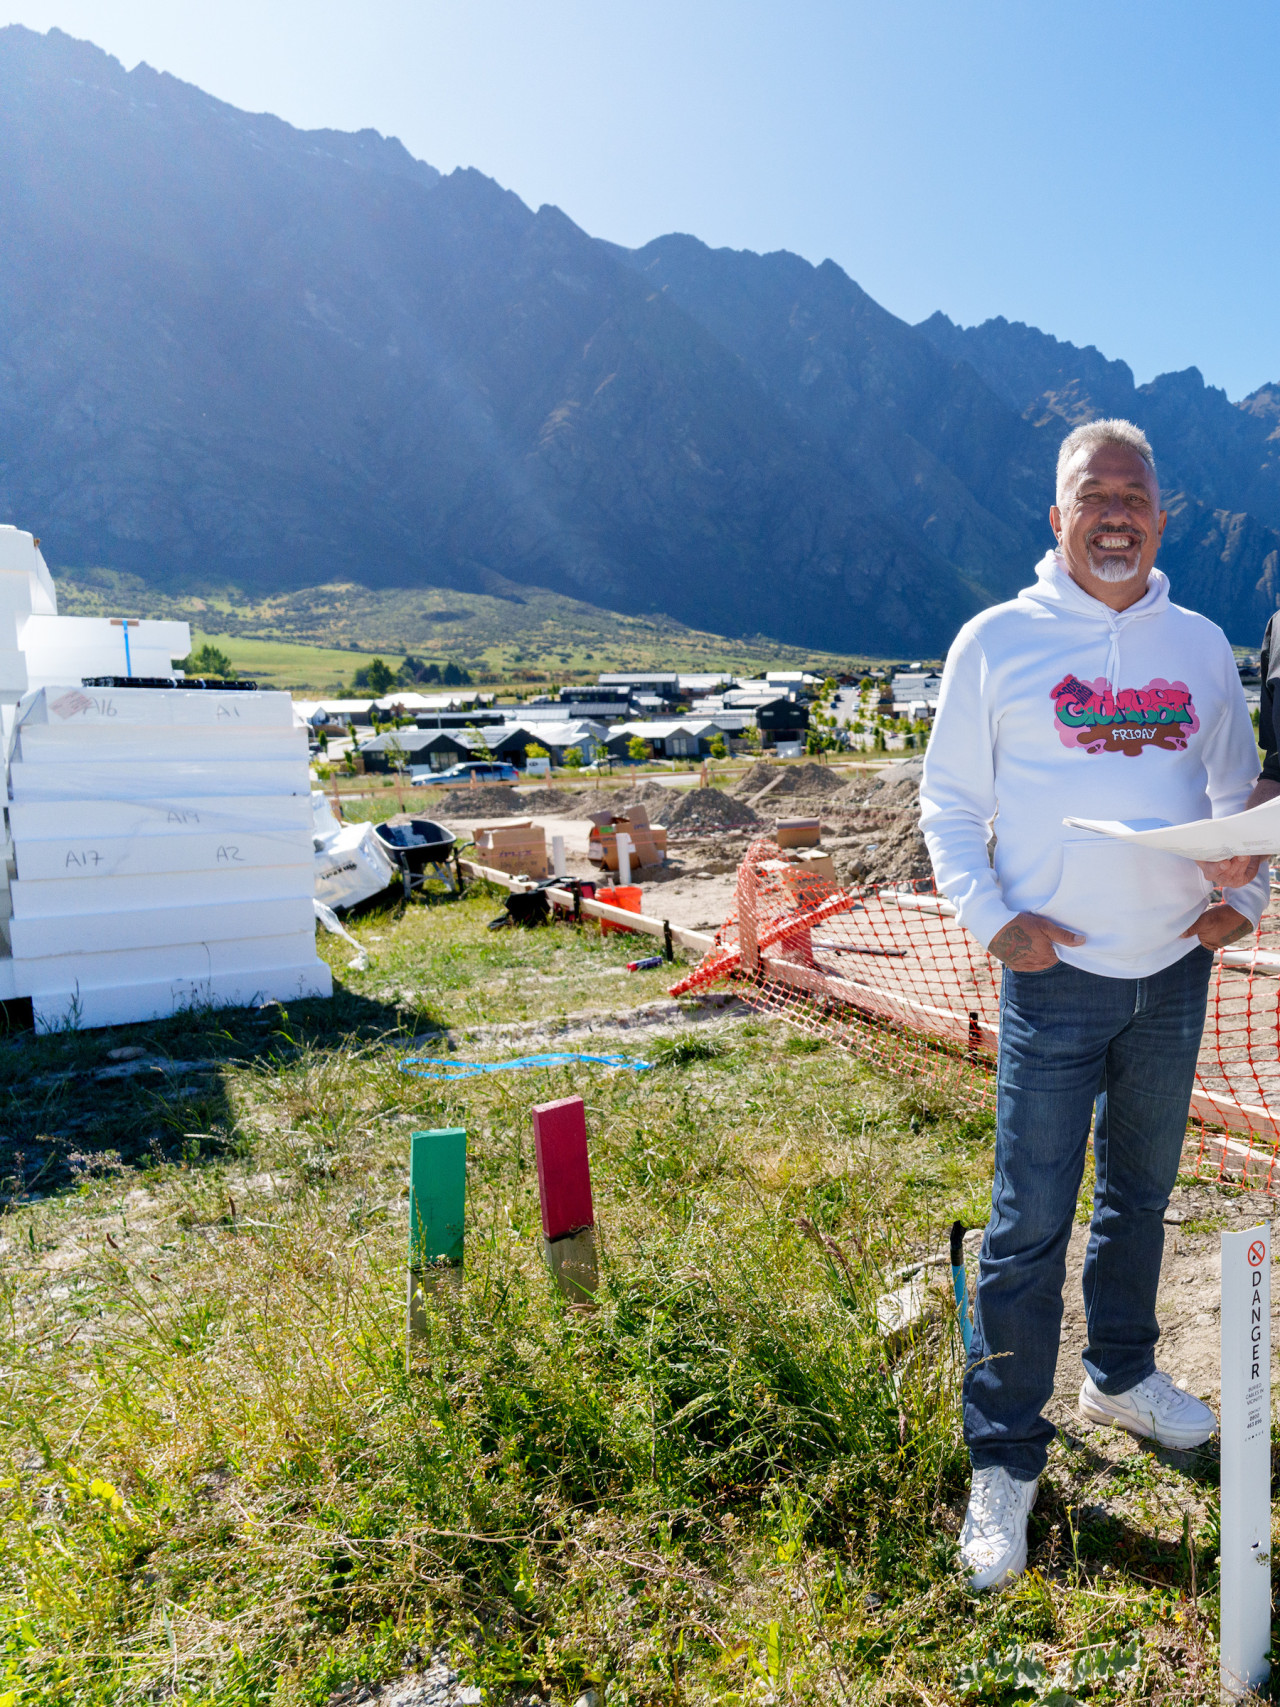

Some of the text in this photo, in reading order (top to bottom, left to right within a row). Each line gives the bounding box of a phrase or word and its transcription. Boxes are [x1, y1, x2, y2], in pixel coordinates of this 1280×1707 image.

[216, 704, 240, 720] A1
[1112, 728, 1157, 741] FRIDAY
[65, 845, 246, 868] A17 A2
[1251, 1270, 1262, 1380] DANGER
[1245, 1390, 1259, 1400] CABLES
[1247, 1395, 1263, 1405] VICINITY
